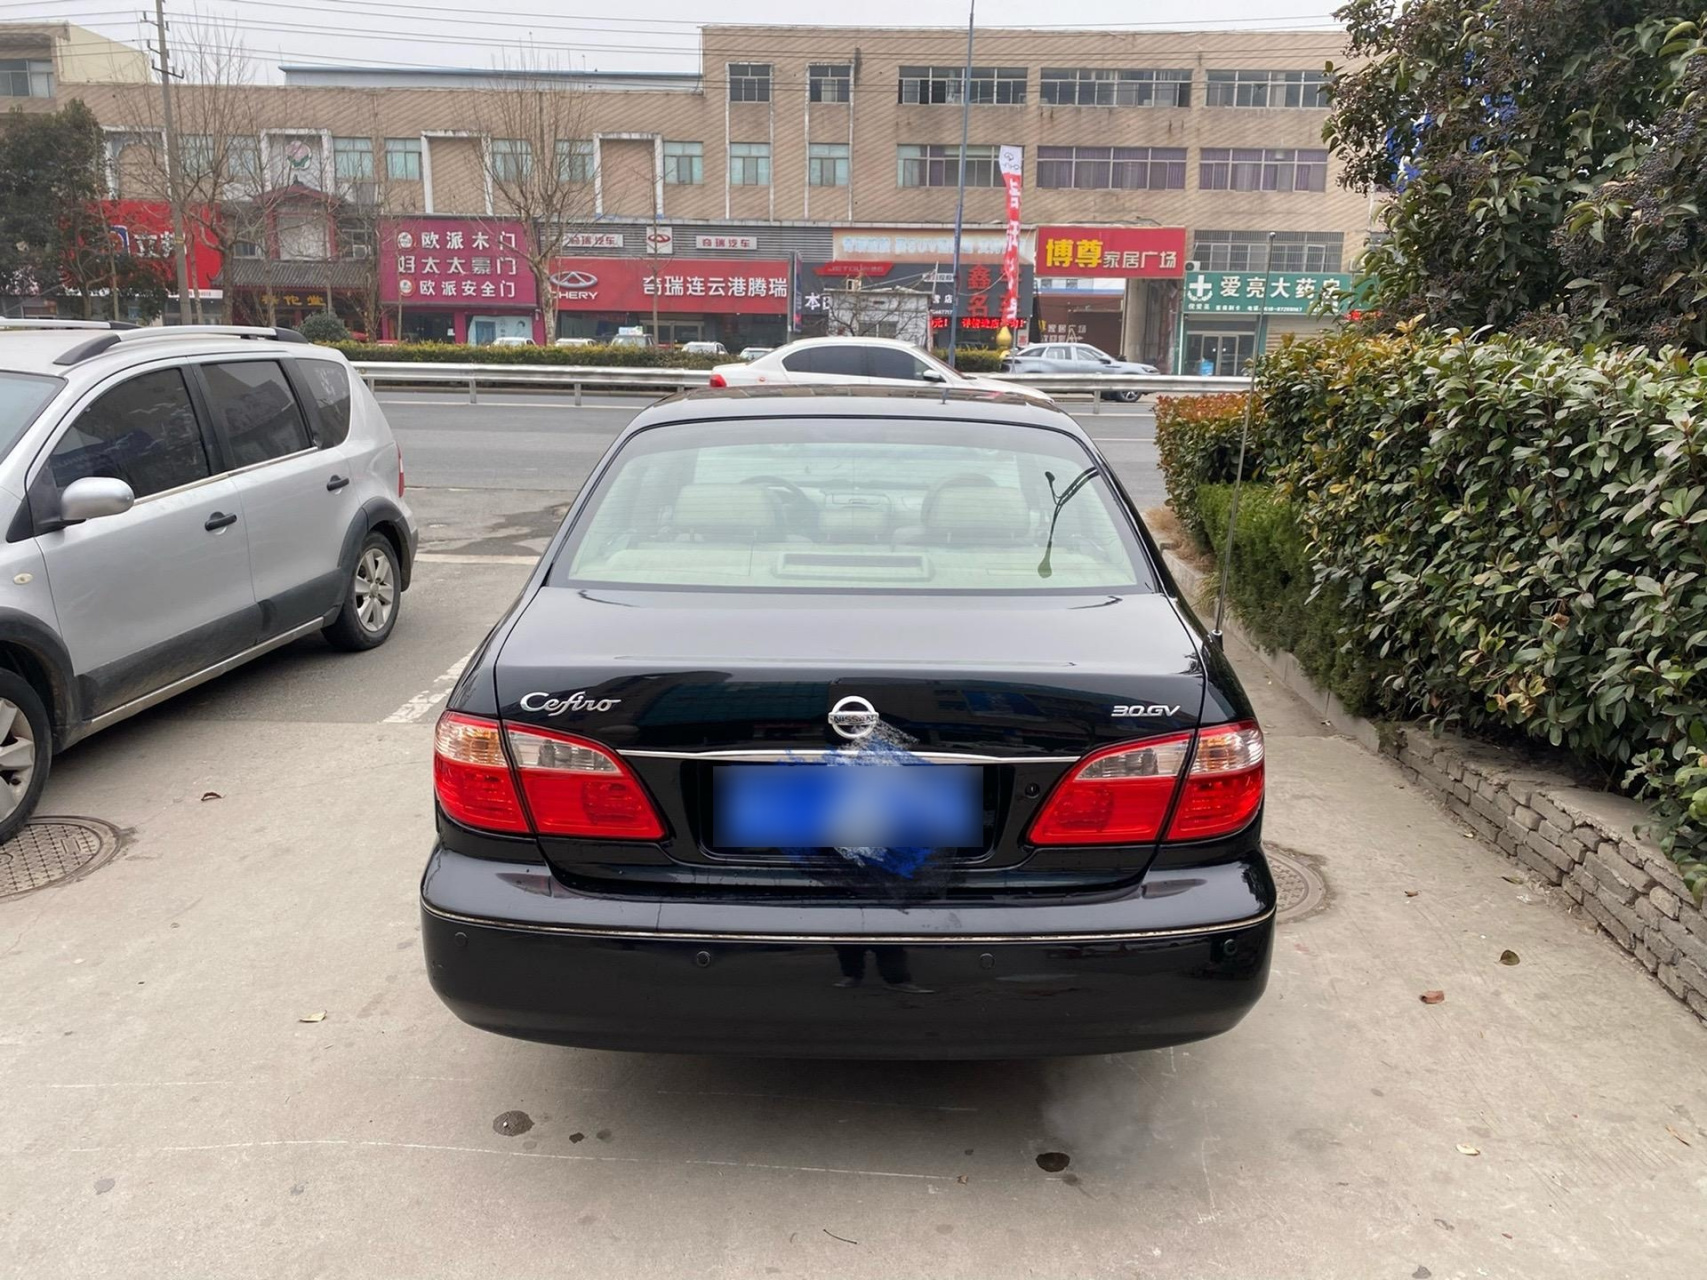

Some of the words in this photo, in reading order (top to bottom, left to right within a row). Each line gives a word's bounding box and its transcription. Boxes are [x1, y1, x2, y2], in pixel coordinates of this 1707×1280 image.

[421, 231, 516, 251] 欧派木门
[702, 238, 751, 249] 奇瑞汽车
[398, 255, 516, 275] 好太太豪门
[419, 280, 515, 298] 欧派安全门
[643, 275, 788, 298] 奇瑞连云港腾瑞
[520, 691, 622, 717] Cefiro
[834, 714, 875, 724] NISSAN
